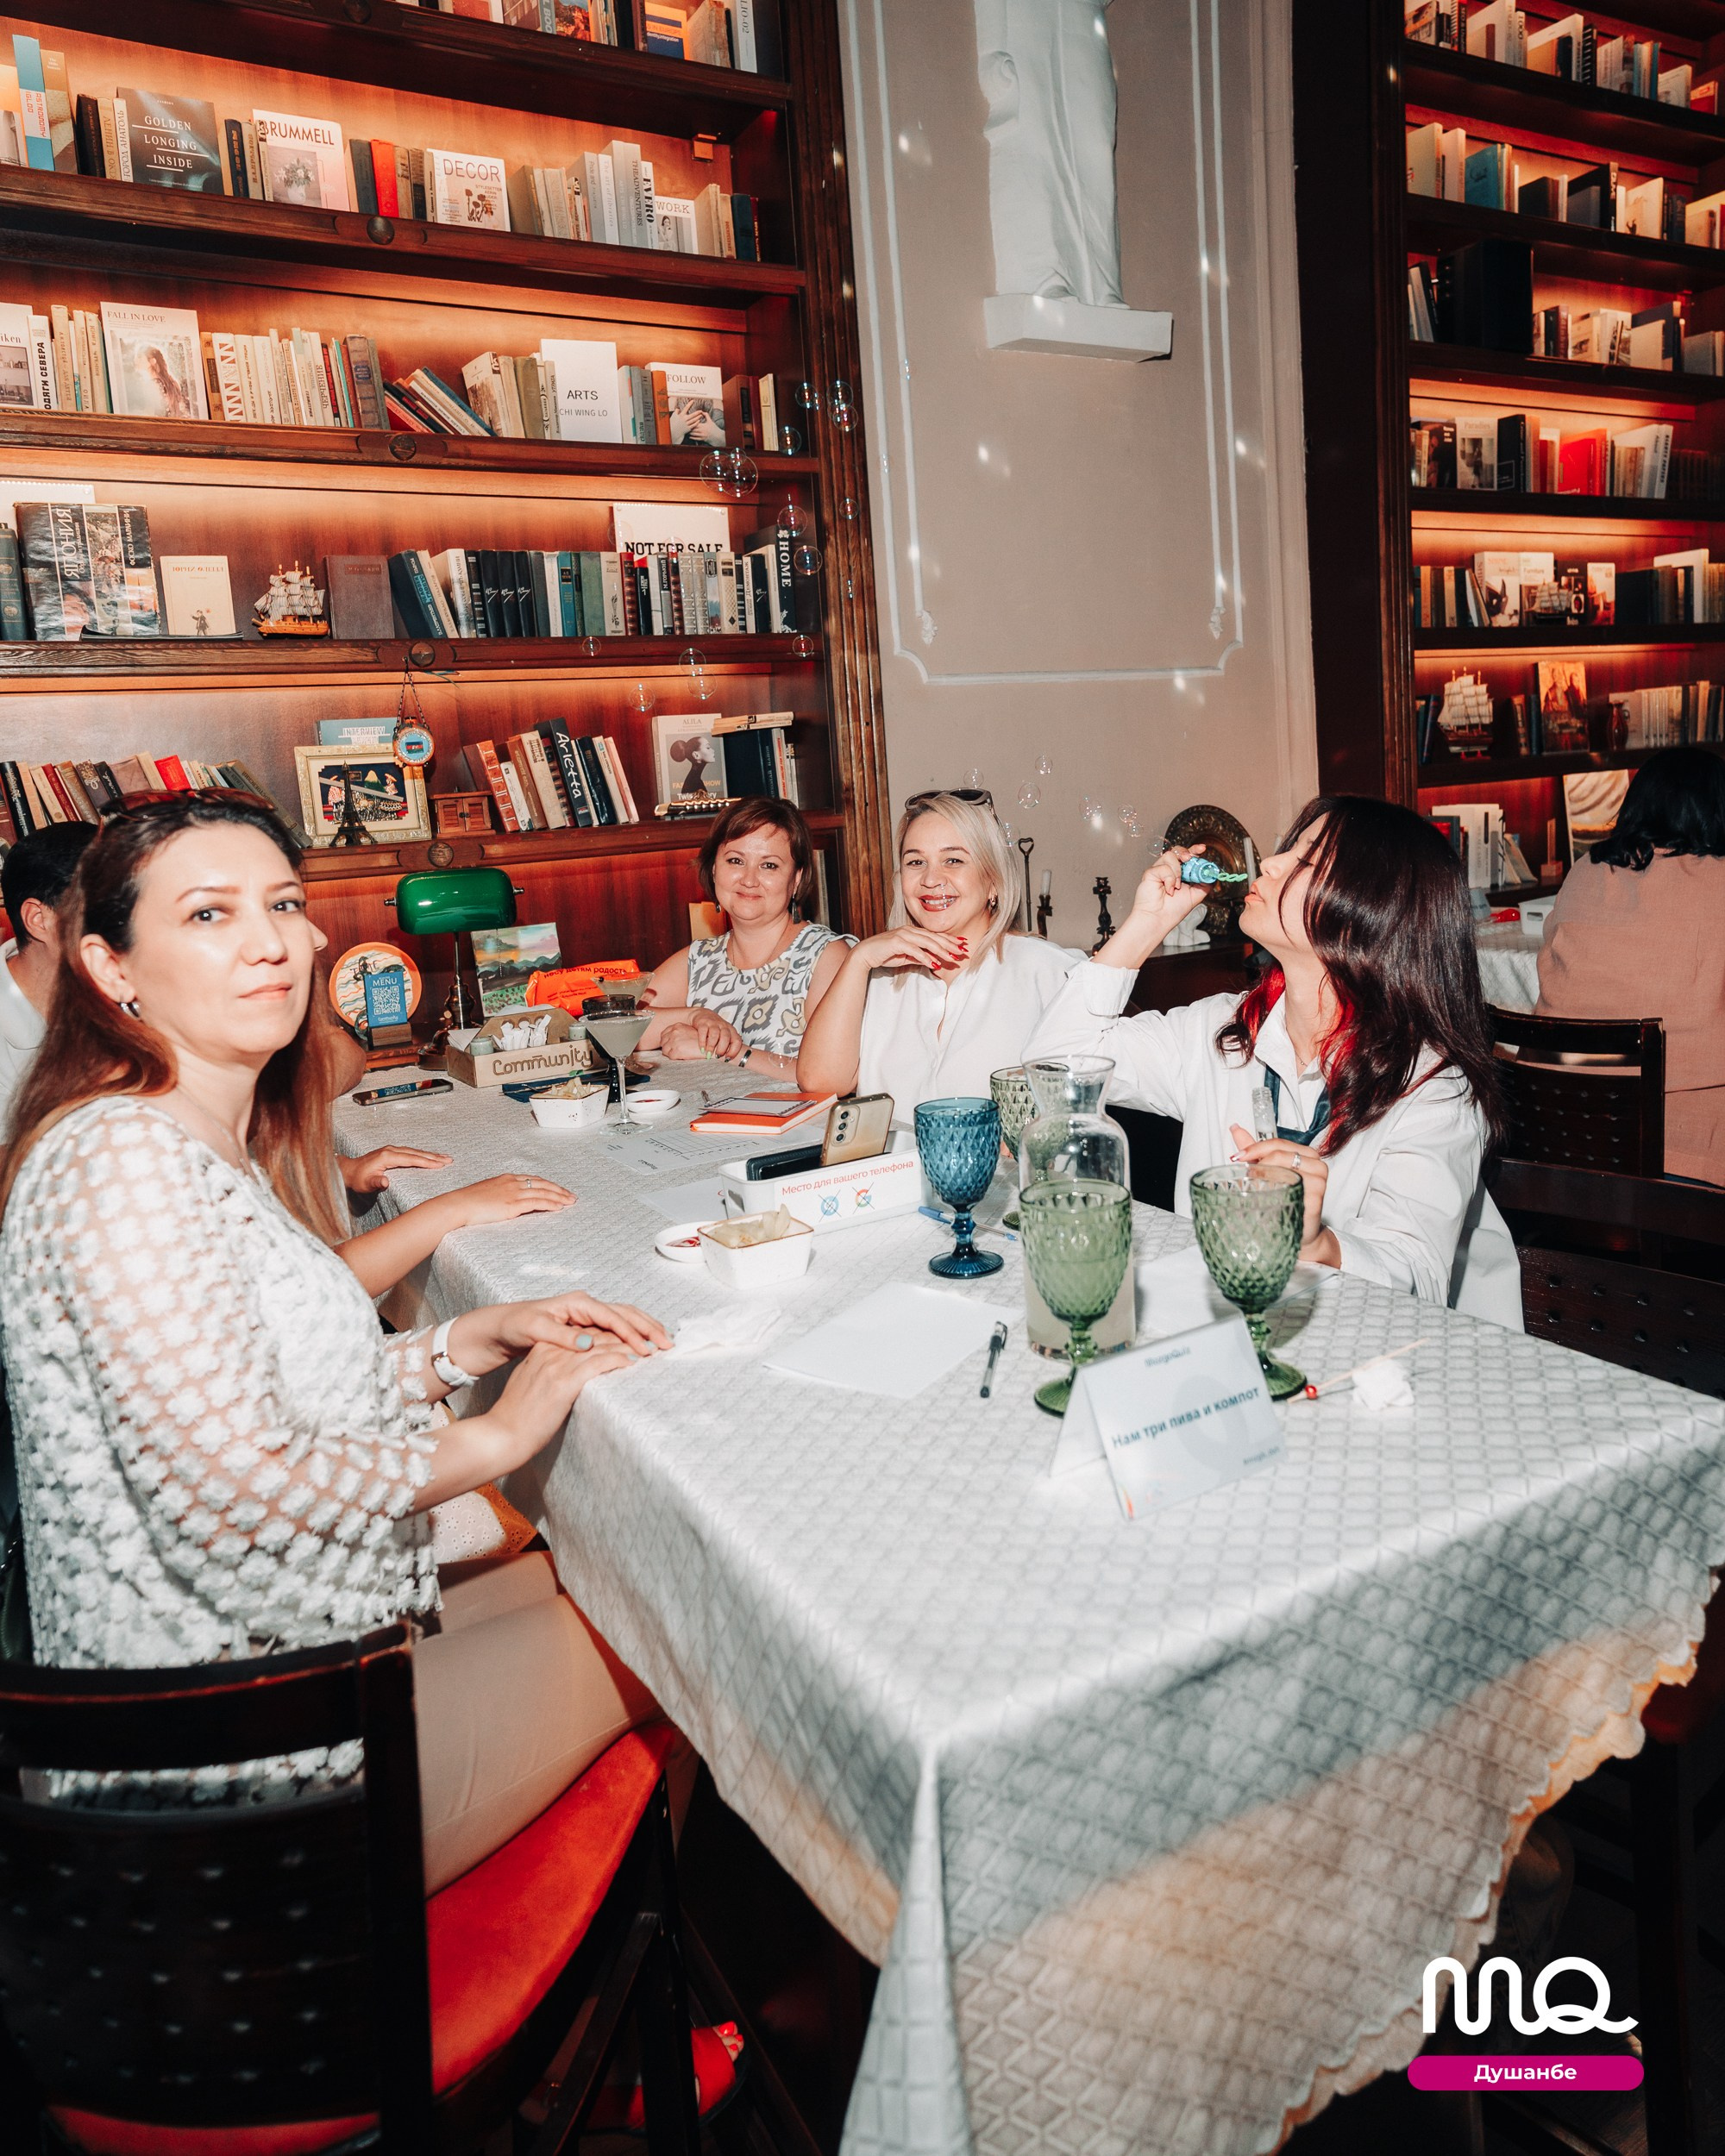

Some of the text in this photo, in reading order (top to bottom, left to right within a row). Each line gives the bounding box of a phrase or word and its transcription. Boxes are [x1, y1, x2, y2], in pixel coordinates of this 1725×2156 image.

[25, 91, 34, 114] IGLOO
[35, 92, 46, 138] ASTRONOMY
[104, 116, 114, 149] ЛЕНИН
[116, 110, 129, 148] АНАТОЛЬ
[144, 116, 191, 131] GOLDEN
[144, 135, 197, 150] LONGING
[154, 154, 192, 168] INSIDE
[442, 158, 501, 183] DECOR
[633, 172, 643, 226] ADVENTURES
[656, 200, 690, 214] WORK
[107, 311, 129, 320] FALL
[142, 314, 166, 323] LOVE
[37, 342, 48, 377] СЕВЕРА
[316, 364, 329, 410] ЧЕРЧЕНИЕ
[667, 373, 706, 385] FOLLOW
[567, 390, 599, 401] ARTS
[56, 508, 80, 579] ЯПОНИЯ
[625, 542, 723, 555] NOT FOR SALE
[780, 541, 792, 587] HOME
[343, 726, 386, 736] INTERVIEW
[556, 732, 582, 799] Arletta
[373, 978, 398, 987] MENU
[543, 970, 564, 979] несу
[492, 1044, 593, 1076] Community
[781, 1161, 914, 1195] Место для вашего телефона
[1112, 1387, 1260, 1449] Нам три пива и компот
